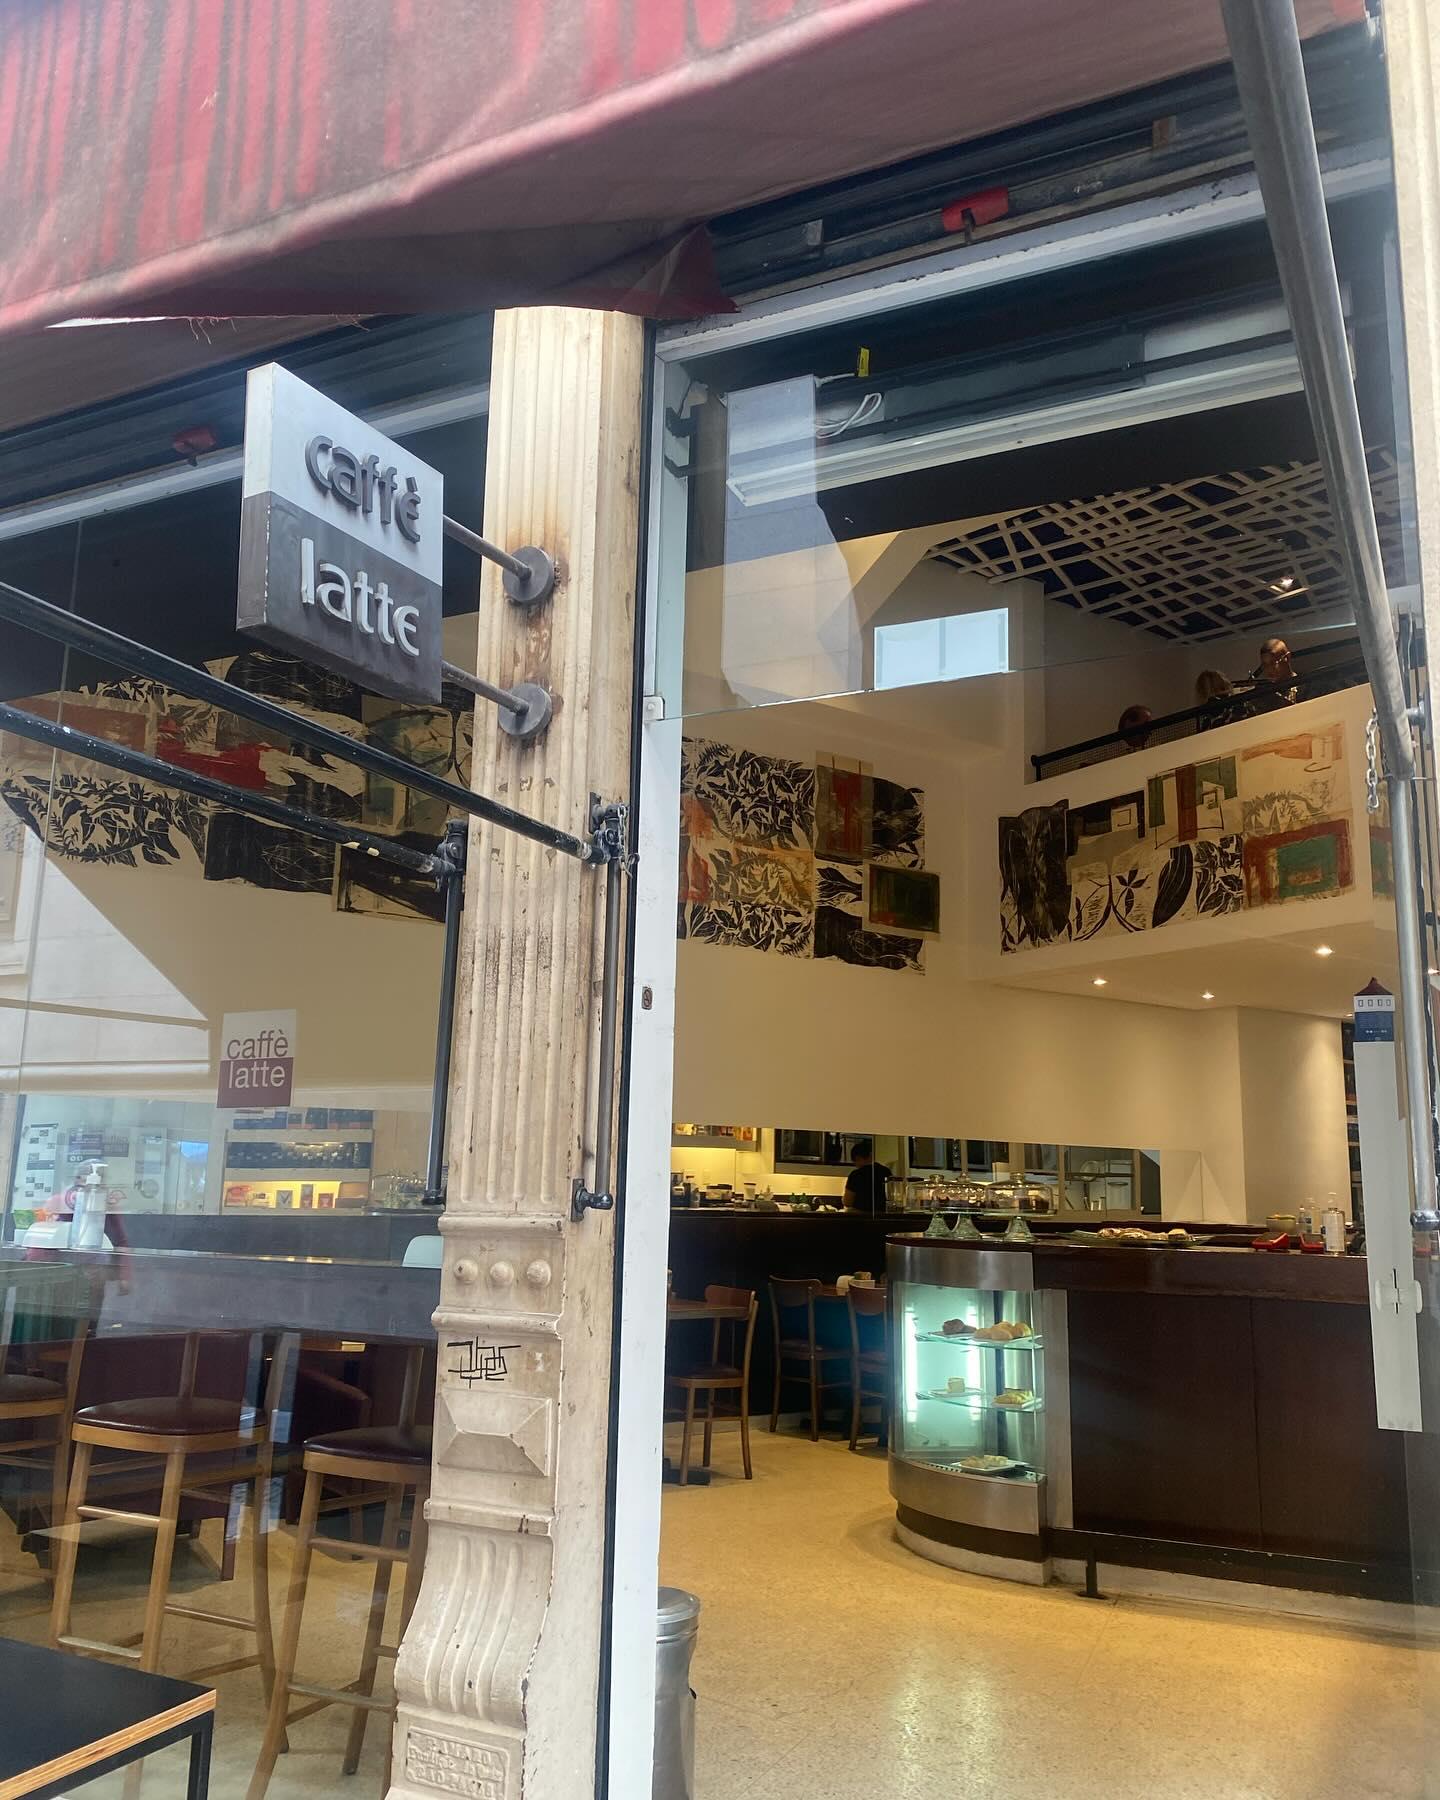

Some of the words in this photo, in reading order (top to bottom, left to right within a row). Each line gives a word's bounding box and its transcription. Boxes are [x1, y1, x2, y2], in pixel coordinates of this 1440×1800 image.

[305, 435, 420, 543] caffè
[301, 538, 420, 656] latte
[227, 1029, 288, 1059] caffè
[229, 1061, 285, 1089] latte
